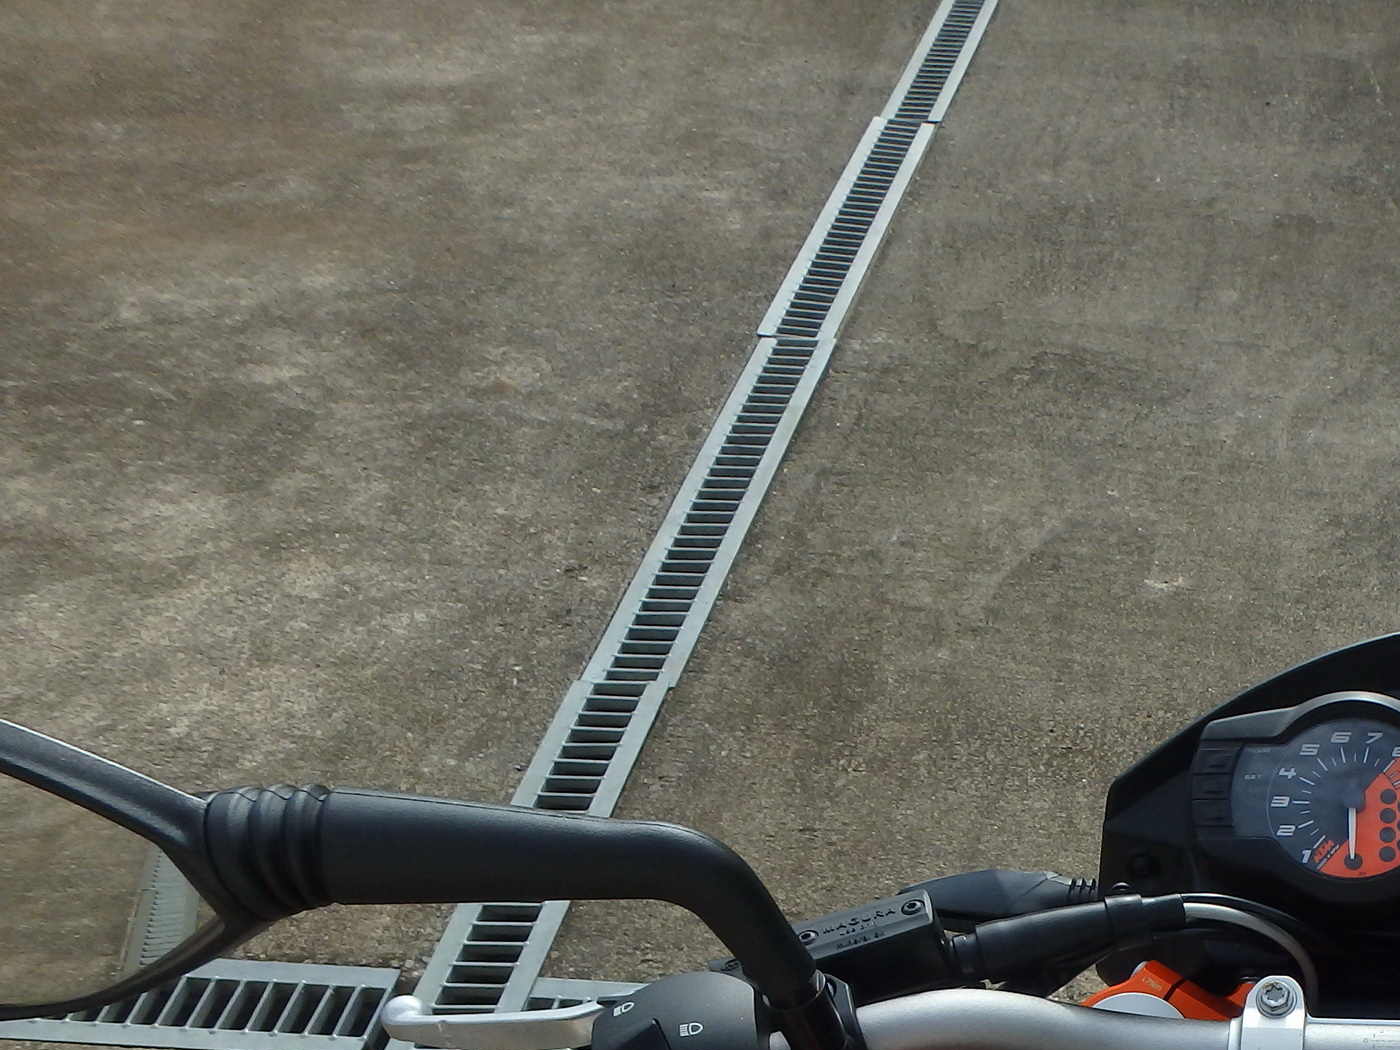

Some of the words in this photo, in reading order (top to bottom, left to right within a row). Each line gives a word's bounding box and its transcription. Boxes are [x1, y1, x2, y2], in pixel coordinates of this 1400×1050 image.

[1330, 732, 1351, 743] 6
[1366, 732, 1383, 744] 7
[1300, 744, 1320, 756] 5
[1279, 767, 1297, 779] 4
[1270, 796, 1290, 807] 3
[1276, 825, 1296, 836] 2
[1302, 849, 1313, 863] 1
[822, 908, 896, 935] MAGURA
